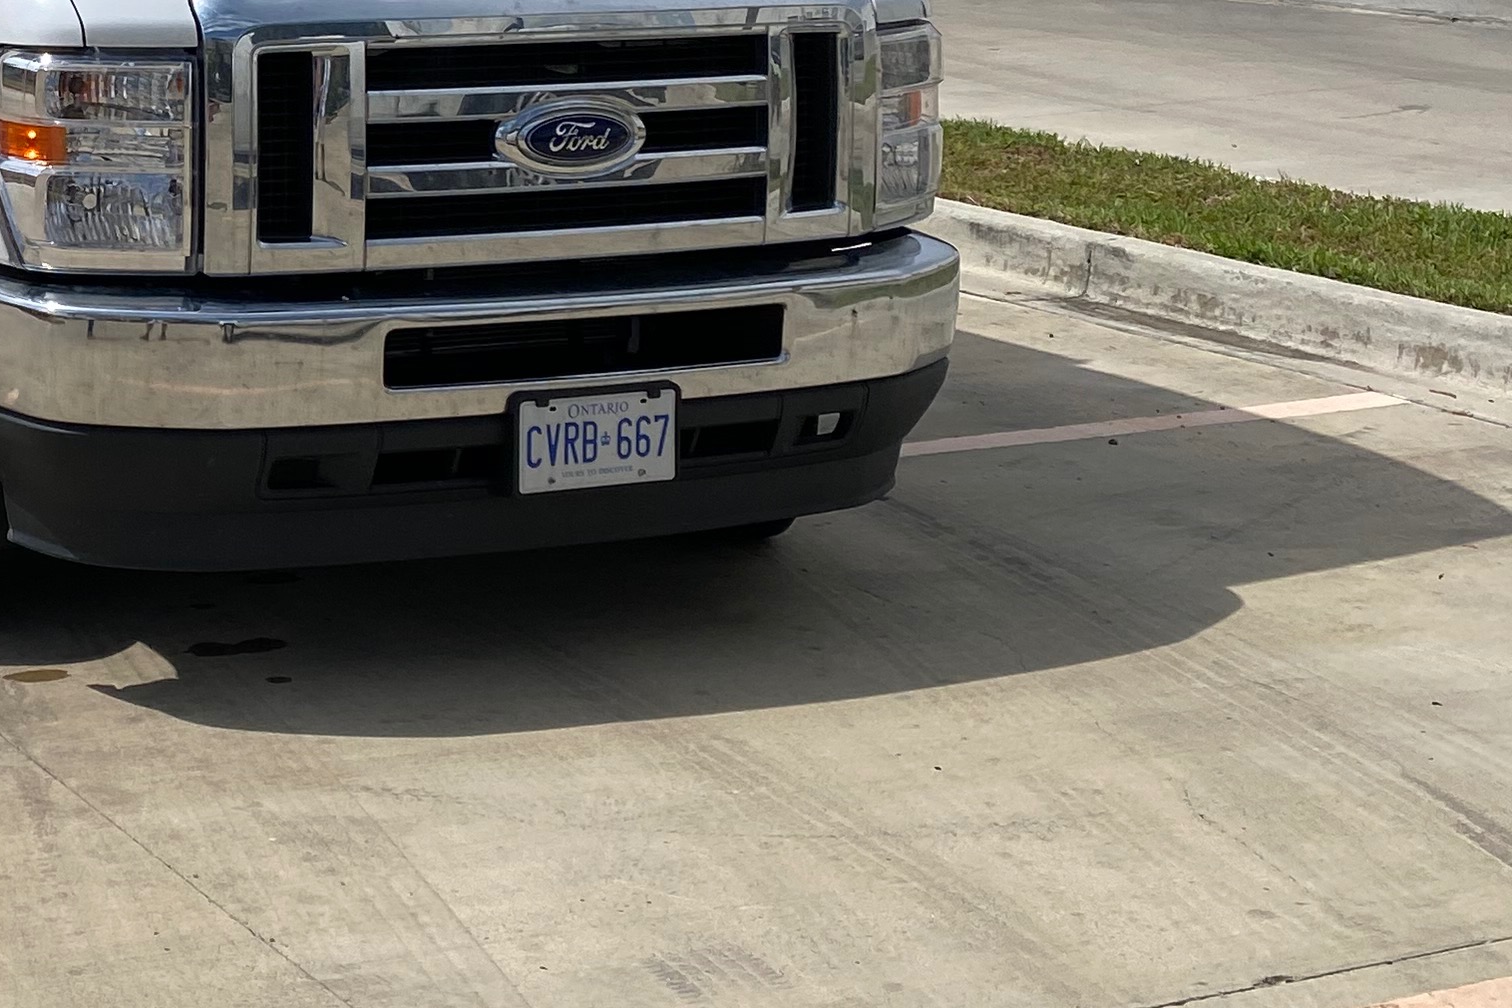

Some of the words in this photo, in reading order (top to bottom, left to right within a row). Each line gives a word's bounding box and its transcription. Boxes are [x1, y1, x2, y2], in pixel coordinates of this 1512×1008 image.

[549, 121, 611, 153] Ford
[567, 400, 630, 419] ONTARIO
[526, 421, 598, 469] CVRB
[616, 414, 670, 460] 667
